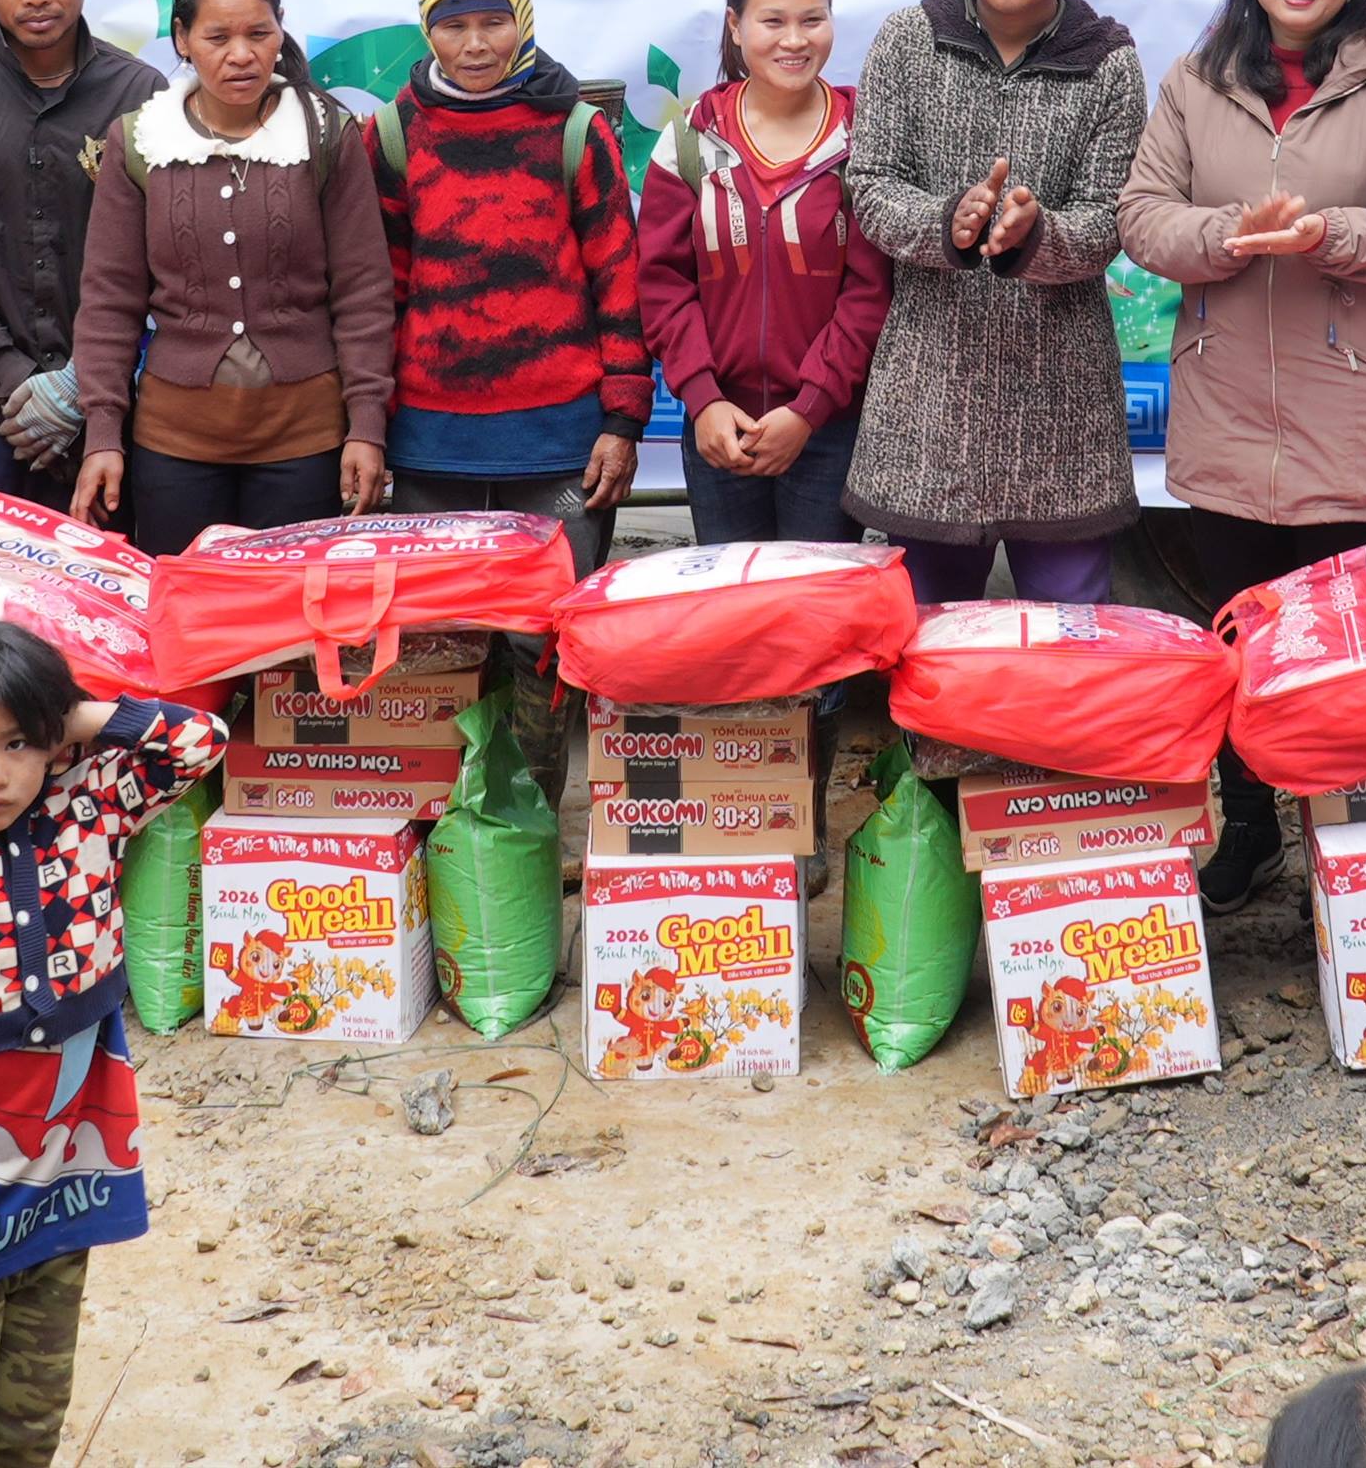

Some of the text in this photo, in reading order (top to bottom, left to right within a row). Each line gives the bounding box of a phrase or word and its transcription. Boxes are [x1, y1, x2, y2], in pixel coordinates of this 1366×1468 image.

[65, 561, 122, 593] CAO
[273, 691, 372, 718] KOKOMI
[379, 698, 427, 720] 30+3
[602, 732, 704, 759] KOKOMI
[714, 740, 762, 763] 30+3
[265, 752, 303, 768] CAY
[306, 753, 357, 771] CHUA
[276, 790, 315, 808] 30+3
[332, 787, 415, 810] KOKOMI
[1006, 796, 1044, 816] CAY
[1048, 790, 1102, 811] CHUA
[604, 799, 707, 826] KOKOMI
[714, 806, 761, 829] 30+3
[1019, 836, 1060, 858] 30+3
[1078, 822, 1165, 853] KOKOMI
[218, 890, 259, 904] 2026
[267, 875, 367, 912] Good
[283, 898, 396, 942] Meall
[657, 904, 763, 948] Good
[1061, 903, 1168, 958] Good
[606, 930, 649, 943] 2026
[1010, 939, 1054, 956] 2026
[674, 925, 794, 978] Meall
[1082, 921, 1201, 987] Meall
